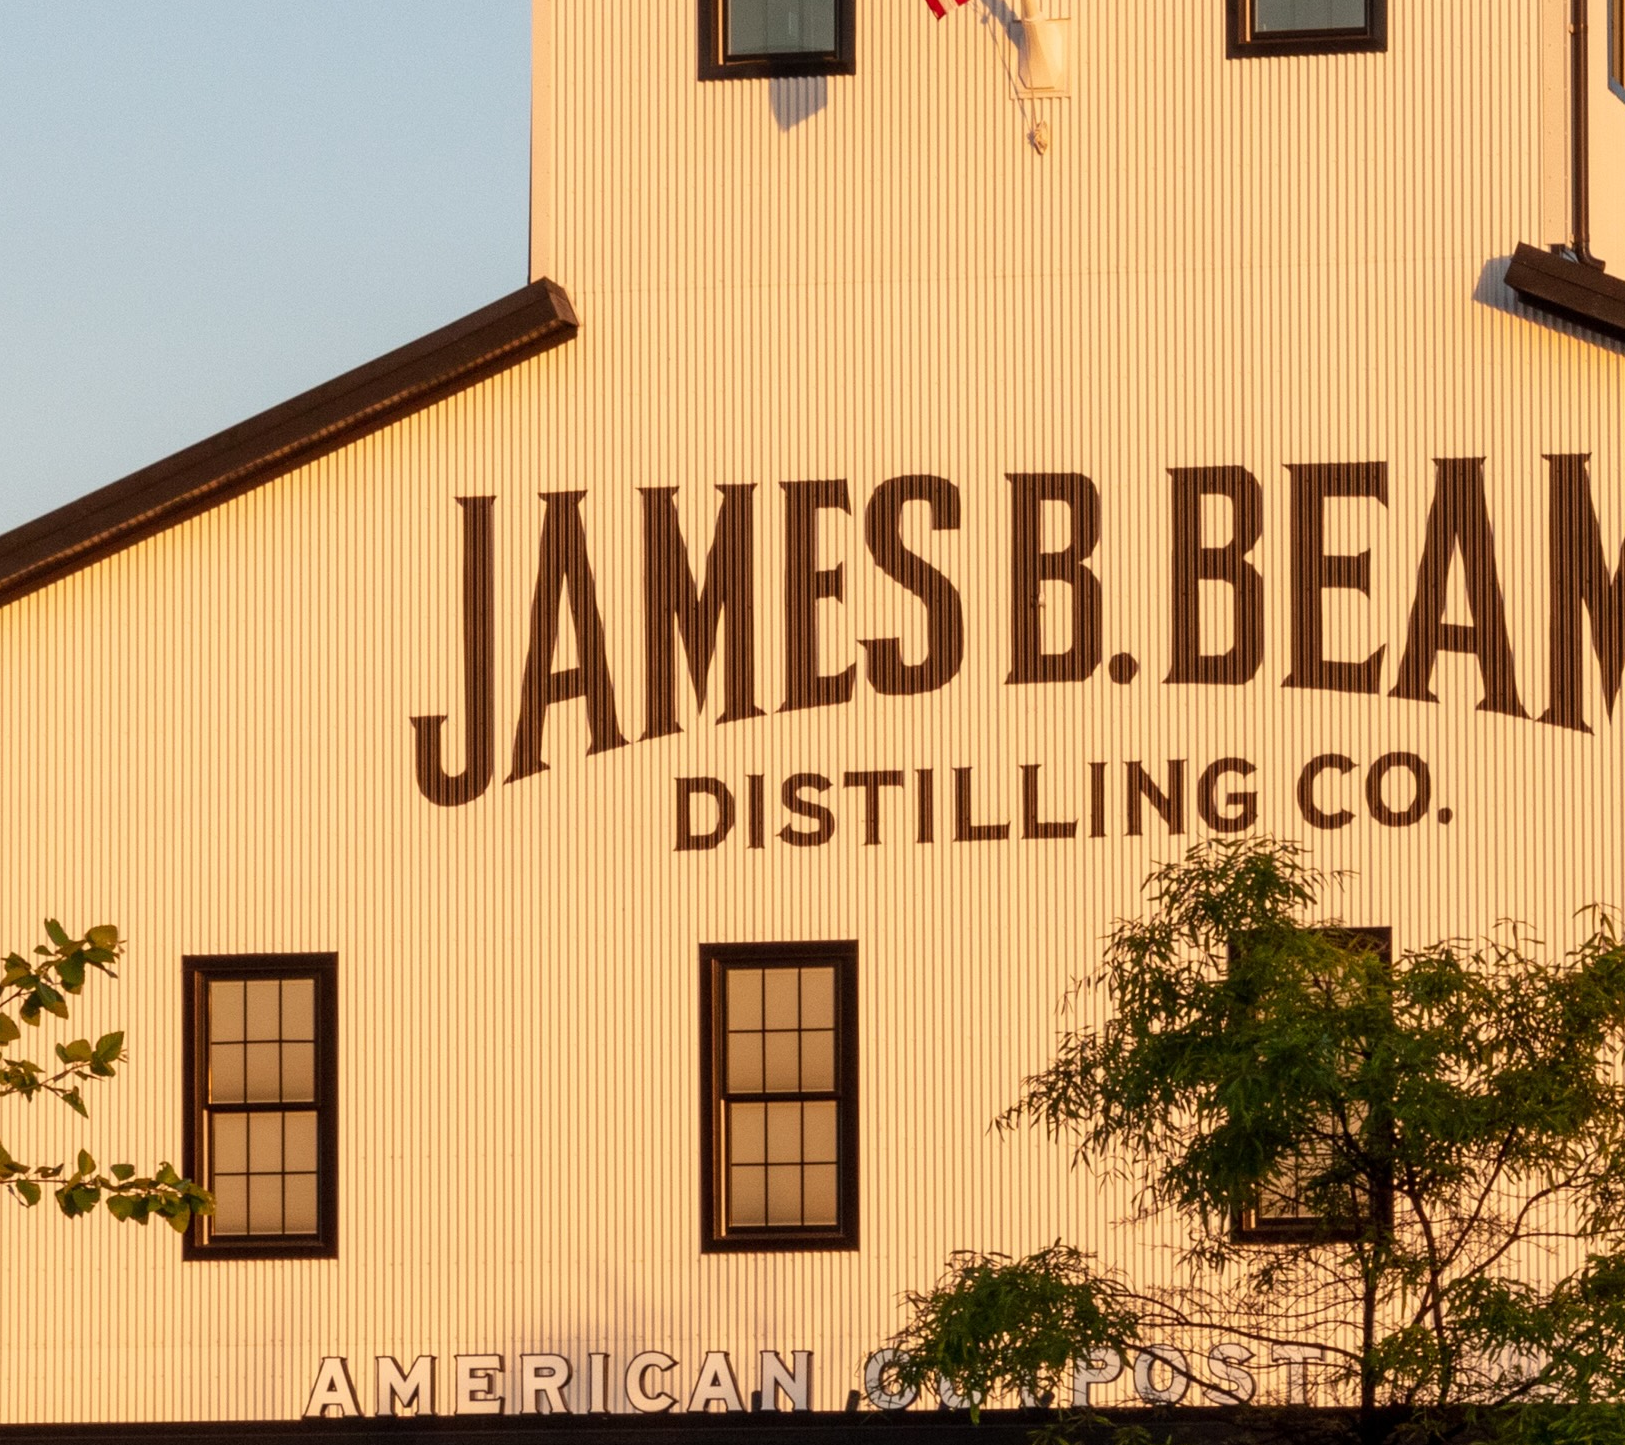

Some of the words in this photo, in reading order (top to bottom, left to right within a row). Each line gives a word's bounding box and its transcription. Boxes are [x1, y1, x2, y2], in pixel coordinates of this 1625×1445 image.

[410, 473, 965, 808] JAMES
[1003, 470, 1140, 688] B.
[672, 753, 1260, 853] DISTILLING
[1295, 751, 1454, 832] CO.
[301, 1349, 814, 1418] AMERICAN
[863, 1342, 1326, 1412] OUPOST
